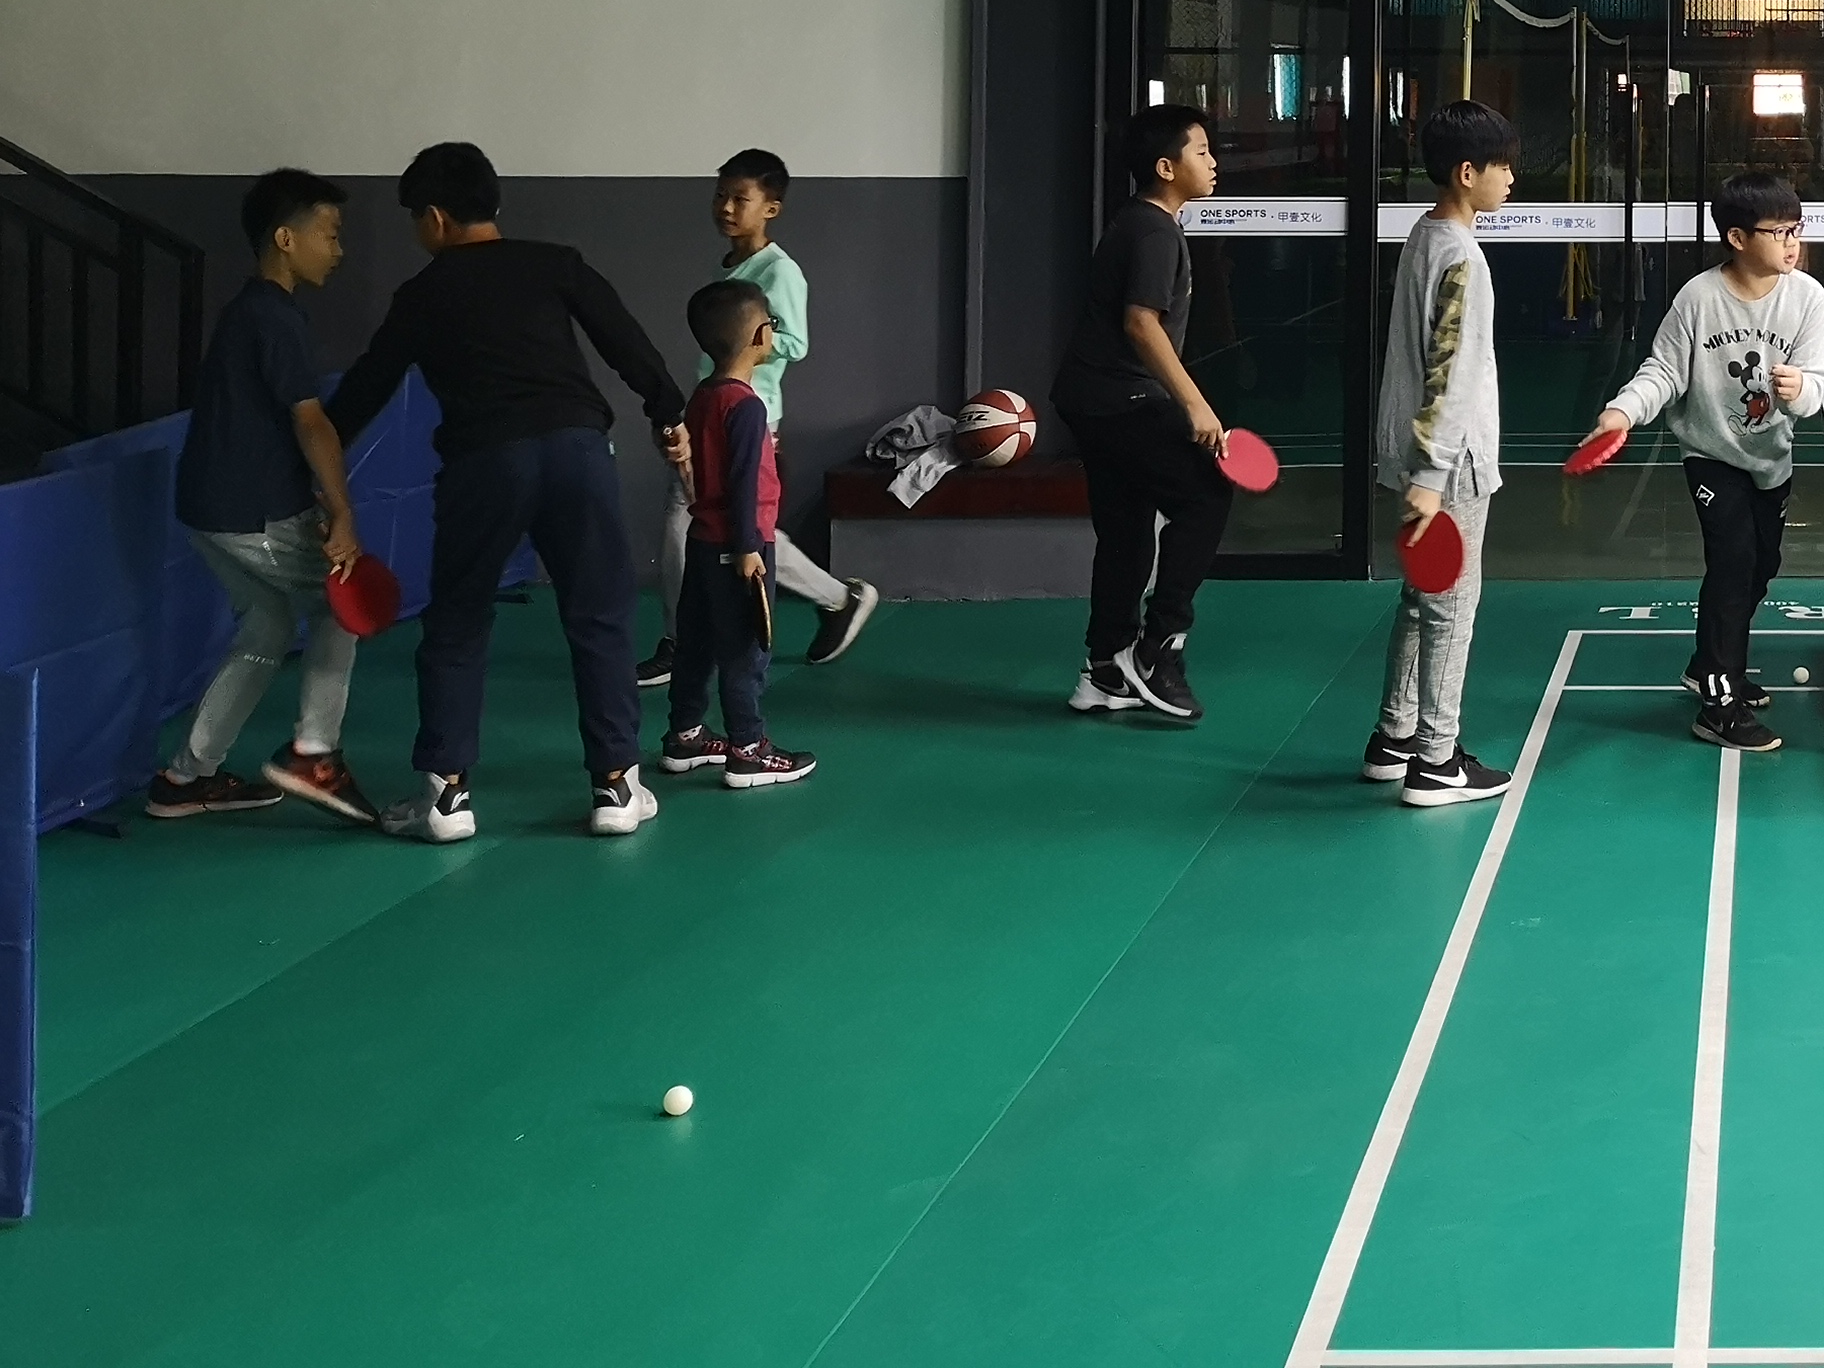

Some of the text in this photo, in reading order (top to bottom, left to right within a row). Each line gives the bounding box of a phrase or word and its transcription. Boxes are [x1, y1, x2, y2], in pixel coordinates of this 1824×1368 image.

[1200, 209, 1267, 218] ONE SPORTS
[1278, 212, 1323, 223] 甲壹文化
[1476, 215, 1542, 224] ONE SPORTS
[1552, 217, 1596, 229] 甲壹文化
[1702, 328, 1793, 357] MICKEY MOUSE
